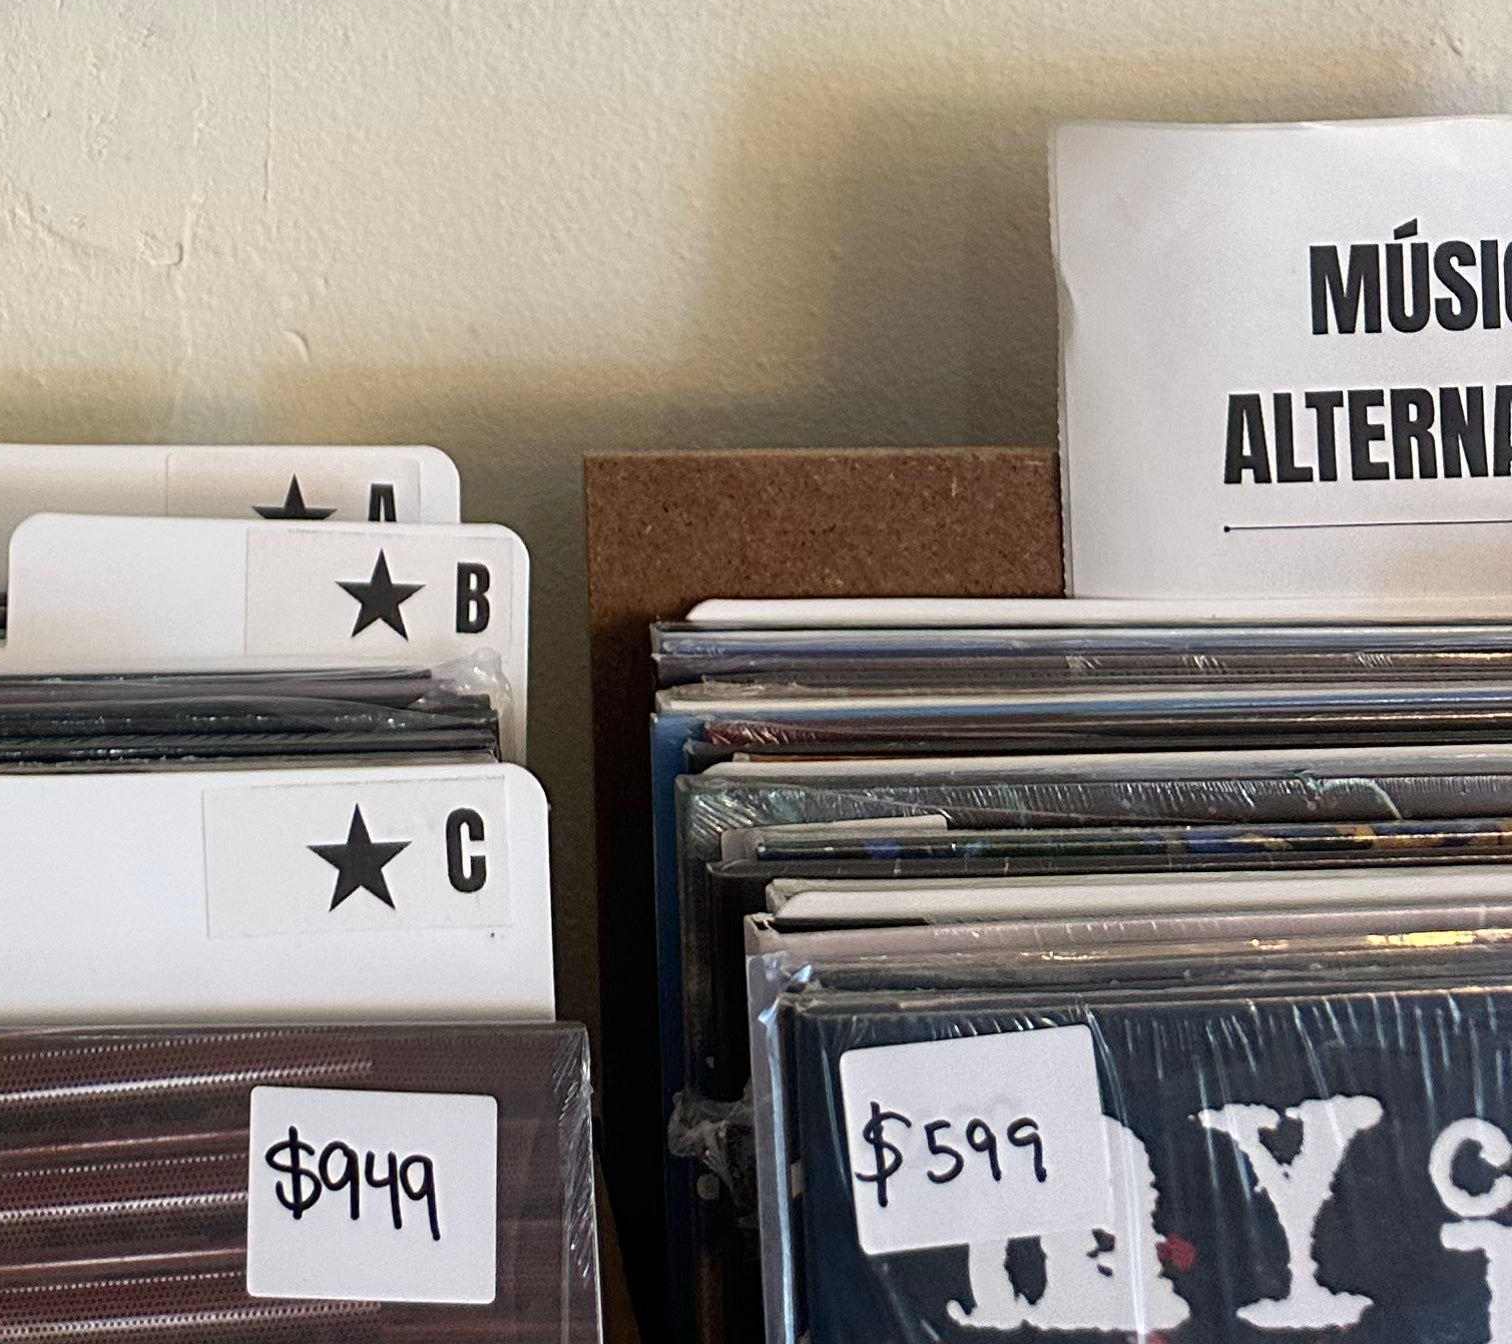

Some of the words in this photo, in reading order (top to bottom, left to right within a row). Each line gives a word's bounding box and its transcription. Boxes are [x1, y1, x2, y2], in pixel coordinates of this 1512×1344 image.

[1309, 218, 1512, 335] MÚSI
[455, 561, 491, 635] B
[445, 807, 488, 894] C
[265, 1125, 441, 1241] $949
[854, 1101, 1047, 1208] $599
